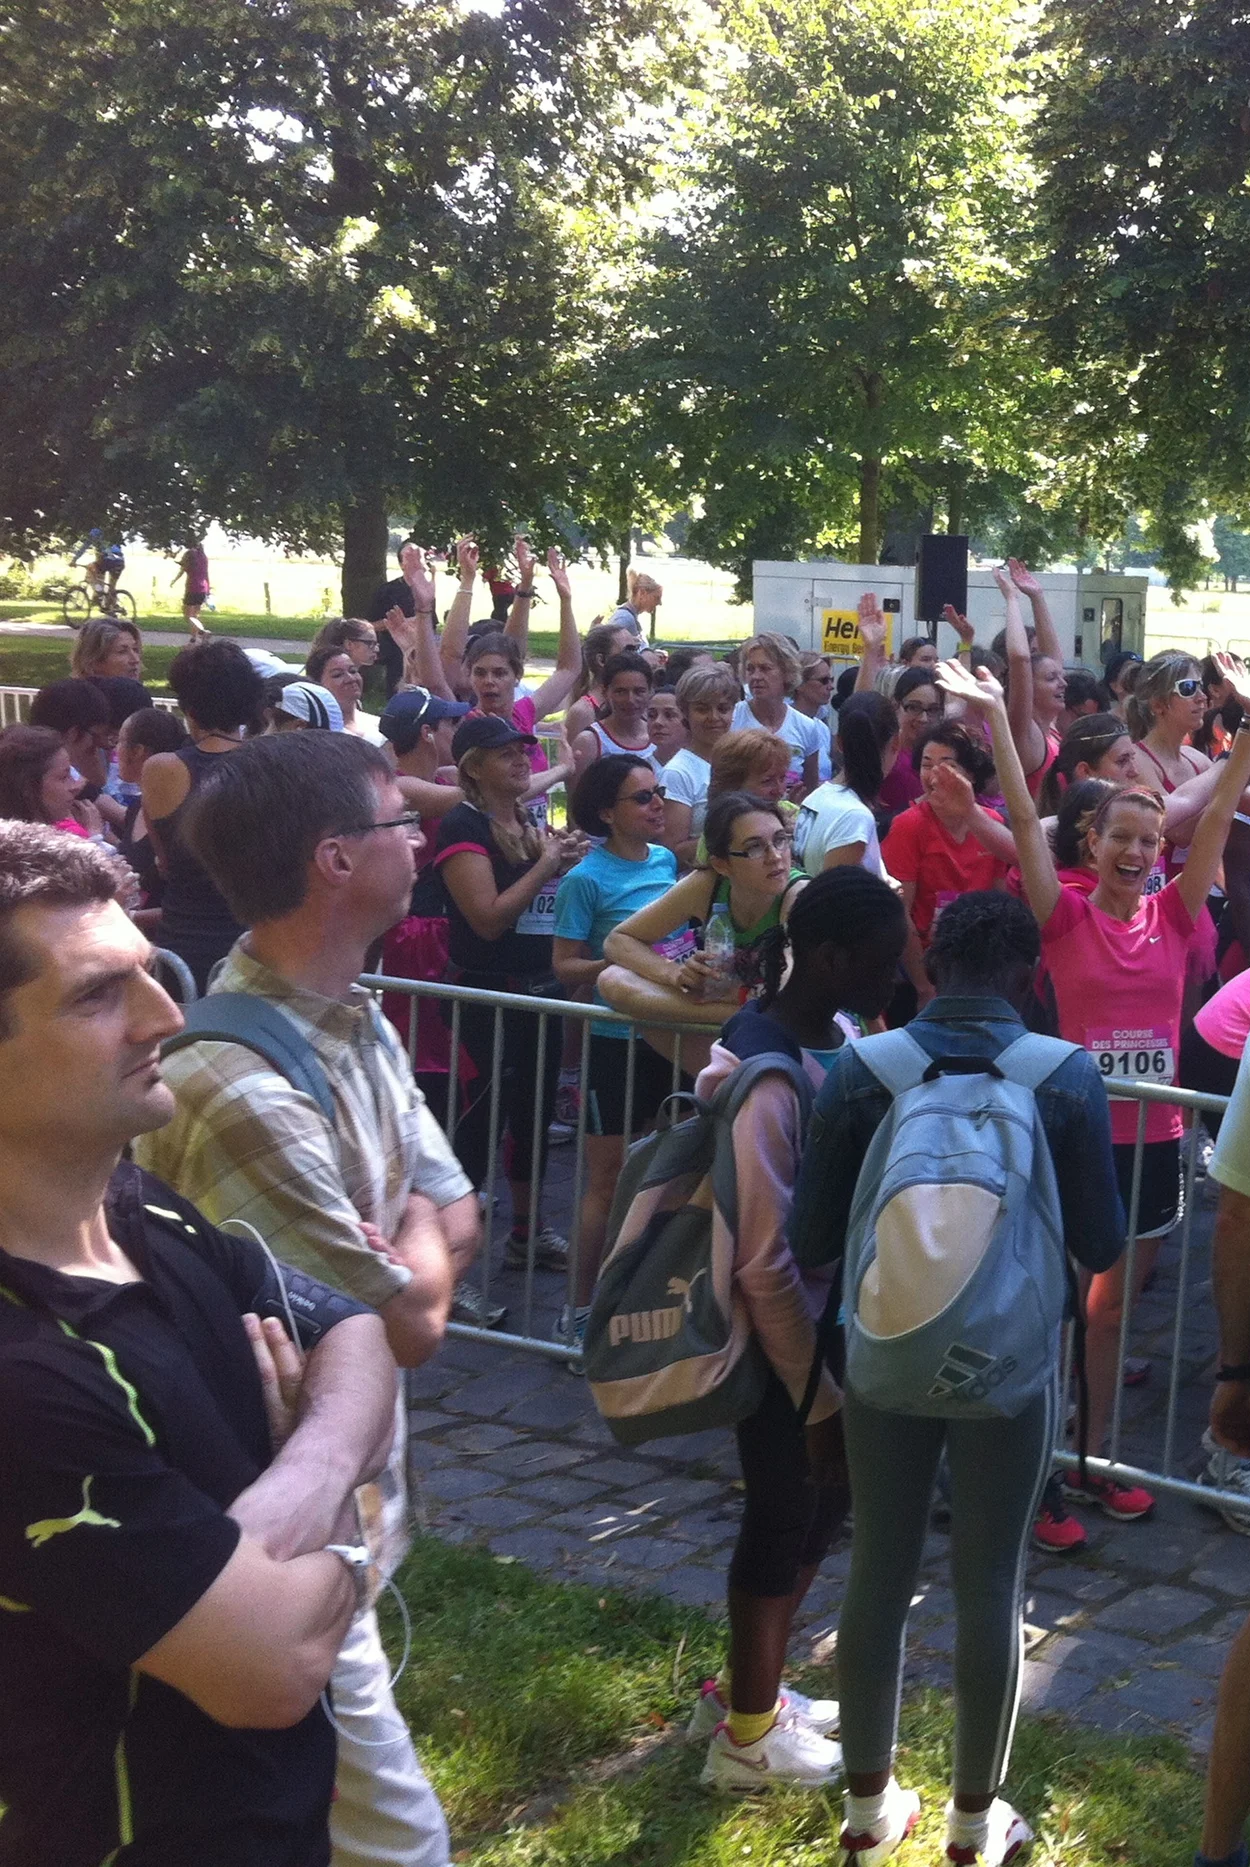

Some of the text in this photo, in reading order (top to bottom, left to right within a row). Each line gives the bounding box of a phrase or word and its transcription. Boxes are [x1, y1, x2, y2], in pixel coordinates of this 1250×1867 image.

[1112, 1029, 1154, 1039] COURSE
[1092, 1038, 1168, 1049] DES PRINCESSES
[1099, 1050, 1166, 1076] 9106
[609, 1306, 684, 1346] PUM
